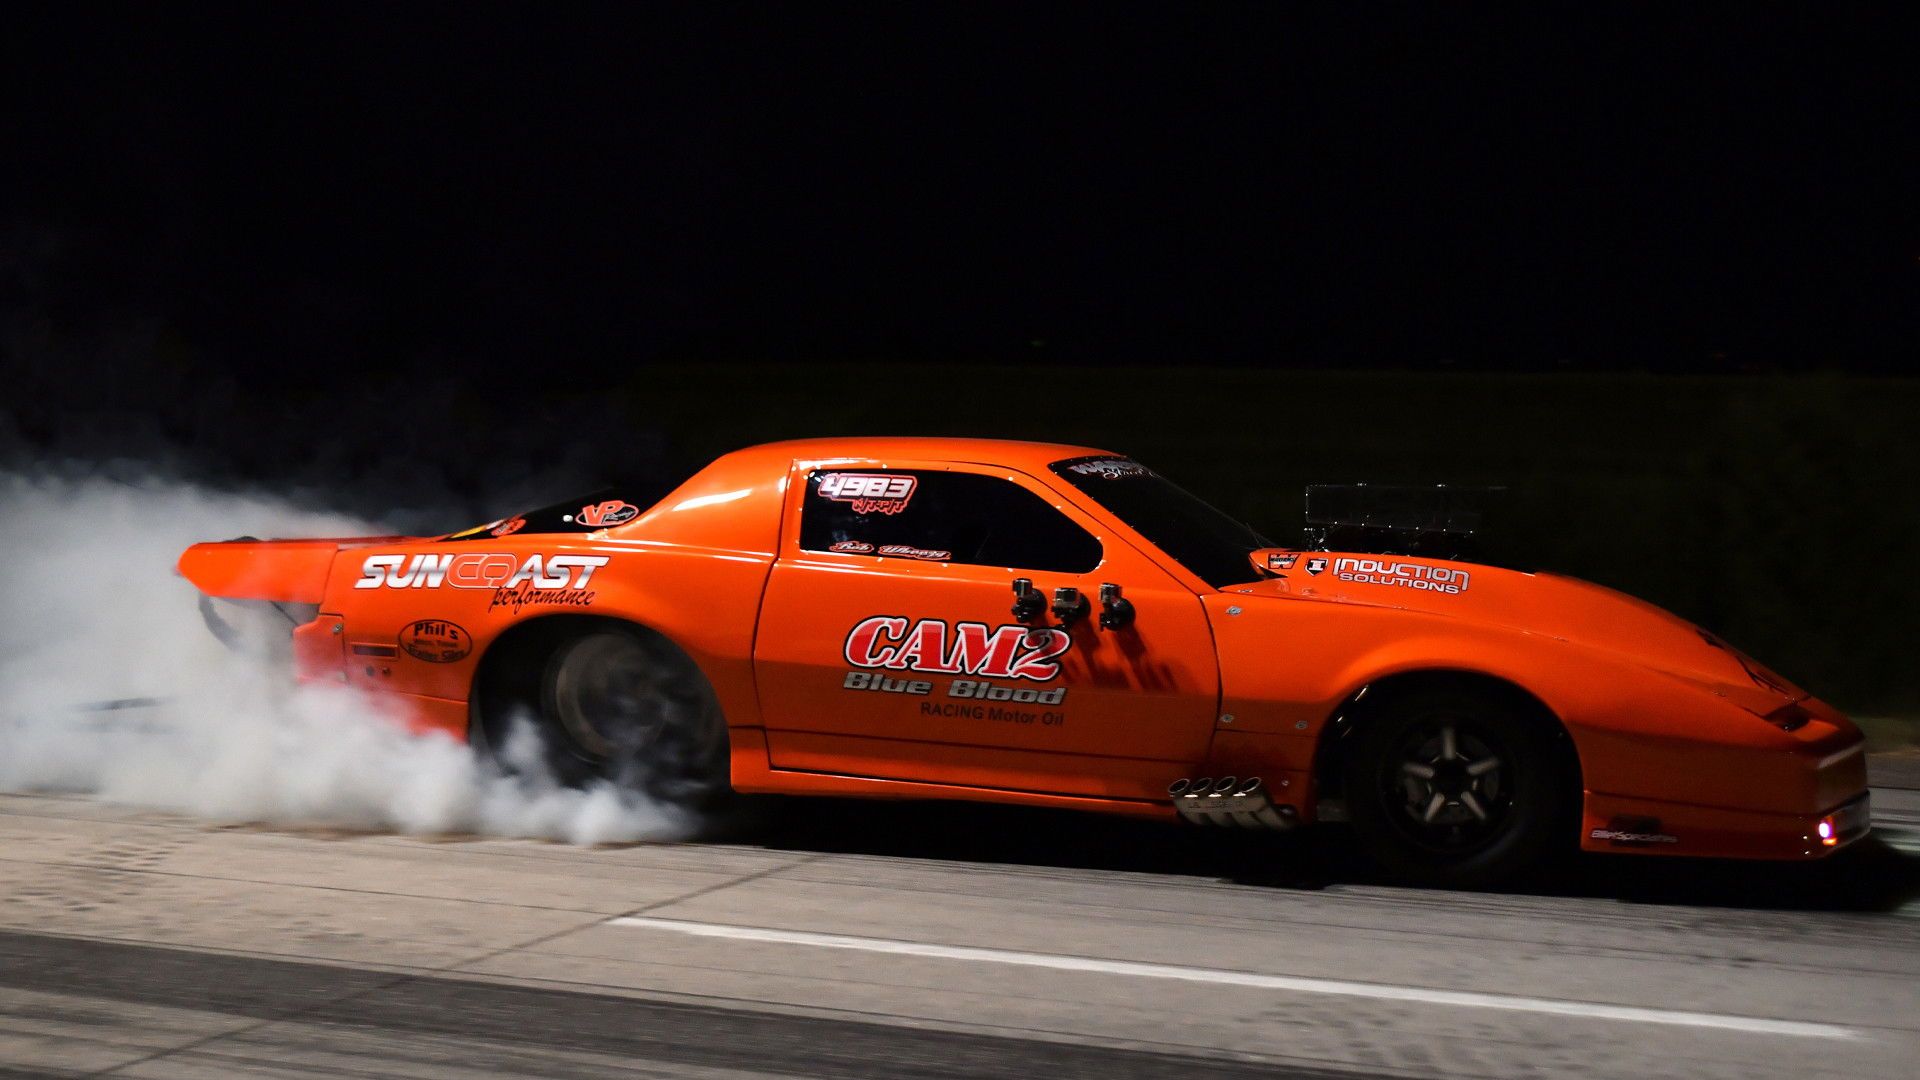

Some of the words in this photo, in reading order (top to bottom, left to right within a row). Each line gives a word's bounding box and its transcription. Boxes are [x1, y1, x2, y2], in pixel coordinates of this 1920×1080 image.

[820, 475, 915, 498] 4983
[583, 500, 625, 524] VP
[354, 553, 610, 589] SUNCOAST
[1332, 558, 1470, 590] INDUCTION
[1339, 572, 1460, 594] SOLUTIONS
[488, 580, 595, 615] performance
[414, 623, 458, 640] Phil's
[844, 616, 1071, 682] CAM2
[843, 672, 932, 695] Blue
[948, 679, 1067, 705] Blood
[920, 702, 984, 720] RACING
[988, 708, 1036, 723] Motor
[1041, 710, 1064, 725] Oil
